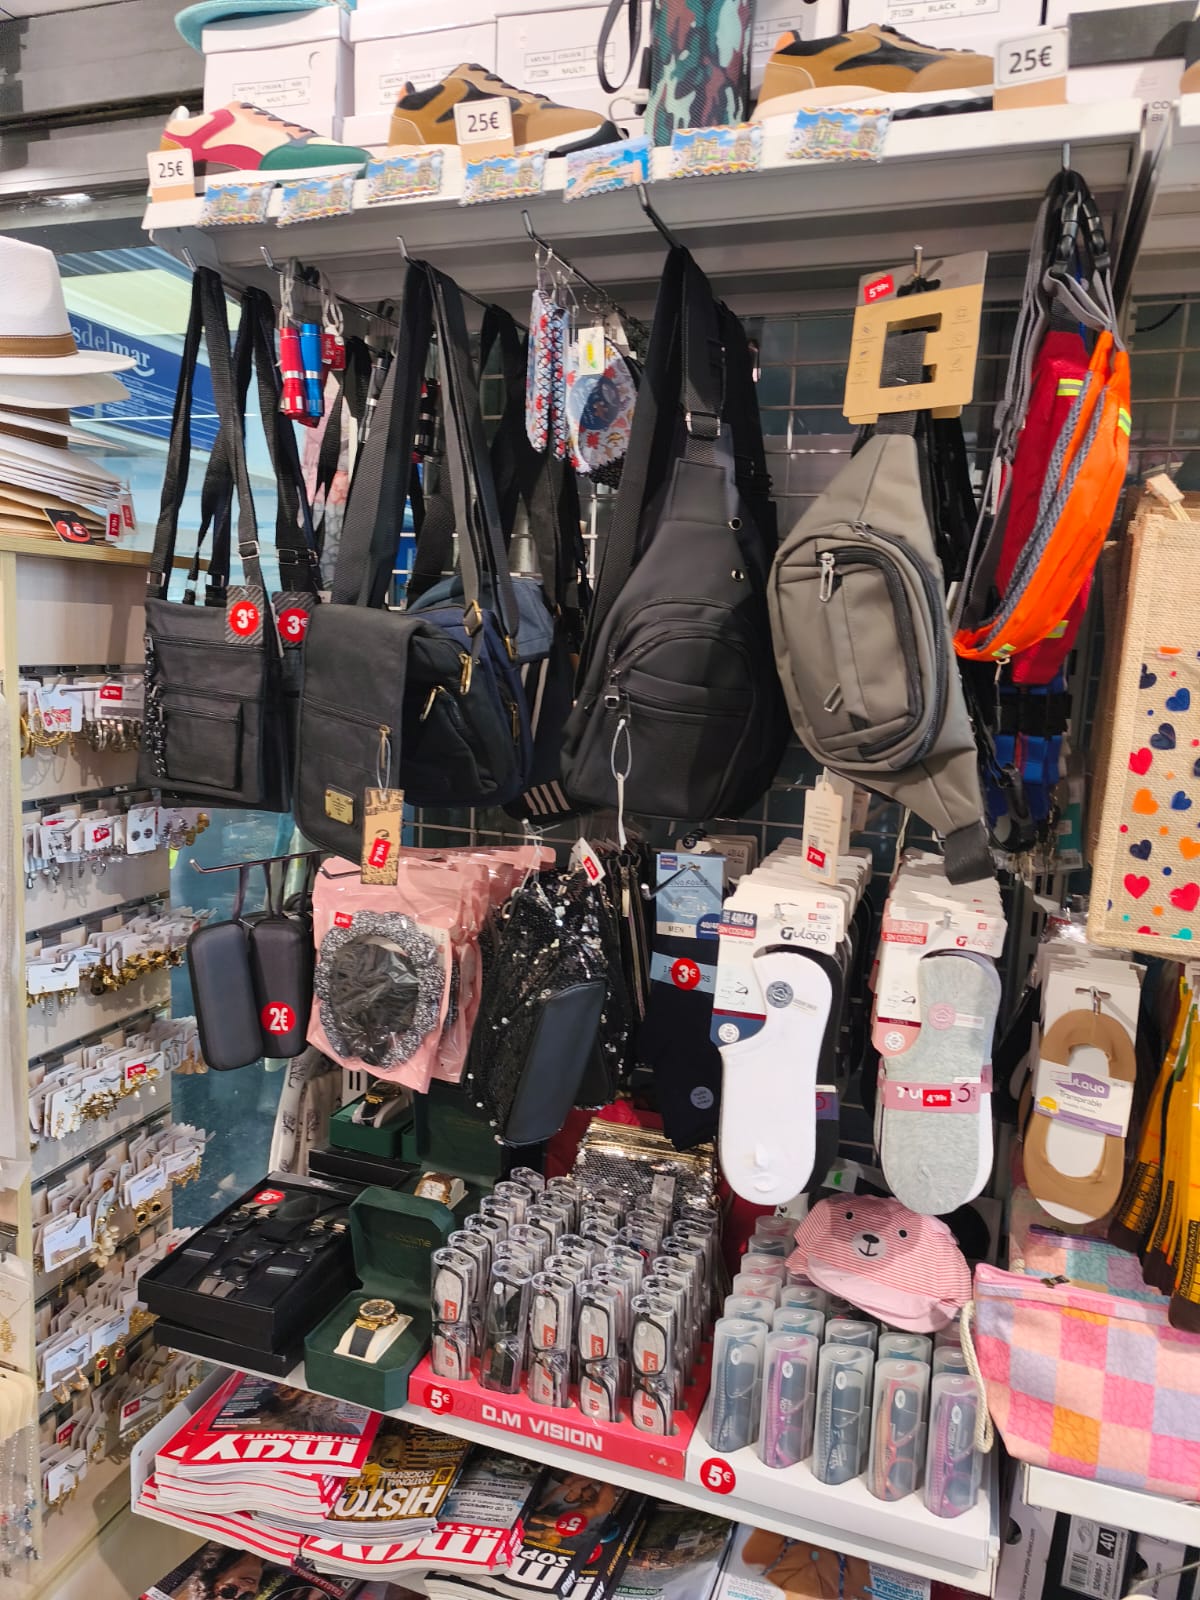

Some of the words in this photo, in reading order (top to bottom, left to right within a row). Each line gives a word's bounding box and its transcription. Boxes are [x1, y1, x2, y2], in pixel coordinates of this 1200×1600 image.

[928, 3, 957, 13] BLACK
[1009, 44, 1053, 74] 25€
[561, 65, 586, 75] MULTI
[467, 111, 499, 134] 25€
[158, 160, 184, 178] 25€
[237, 609, 255, 629] 3€
[287, 615, 309, 635] 3€
[677, 965, 697, 984] 3€
[269, 1007, 288, 1031] 2€
[430, 1389, 451, 1408] 5€
[242, 1433, 361, 1444] INTERESANTE
[528, 1416, 603, 1451] VISION
[378, 1469, 437, 1479] GEOGRAPHIC
[386, 1477, 433, 1486] NATIONAL
[707, 1465, 733, 1488] 5€
[558, 1517, 582, 1532] 5€
[1099, 1532, 1116, 1551] 40
